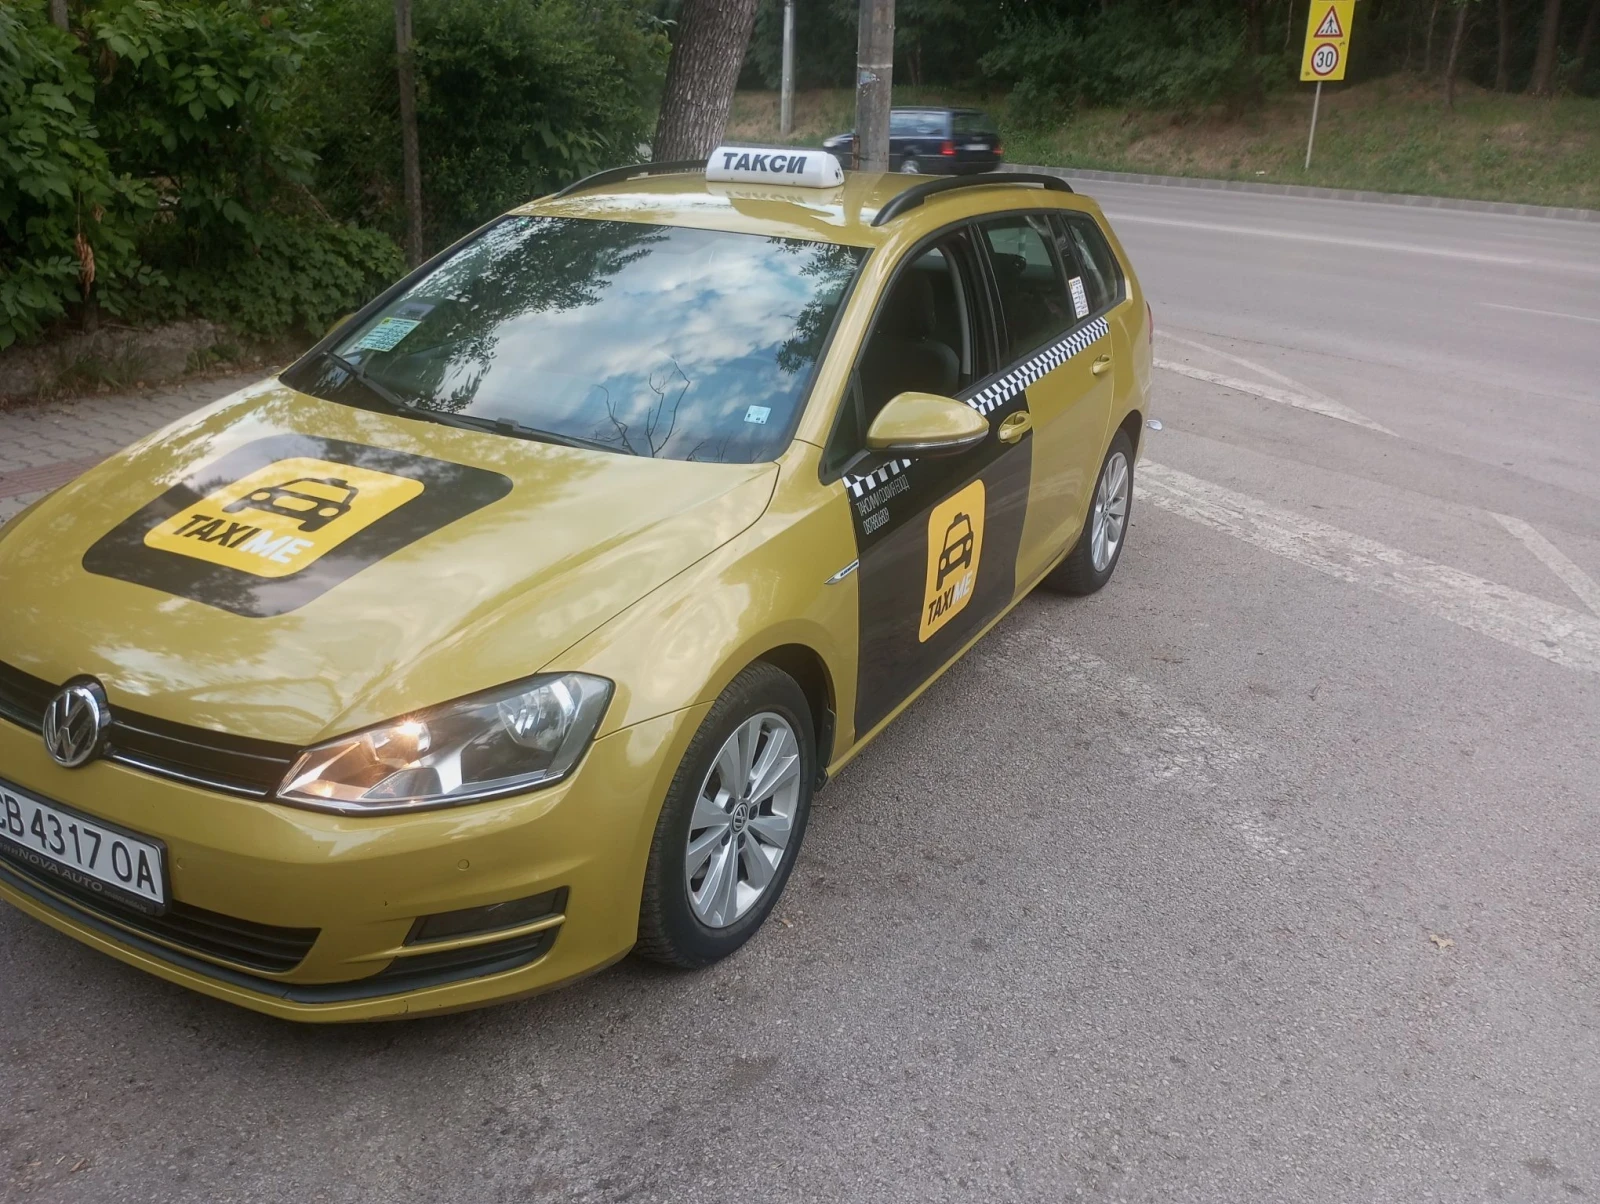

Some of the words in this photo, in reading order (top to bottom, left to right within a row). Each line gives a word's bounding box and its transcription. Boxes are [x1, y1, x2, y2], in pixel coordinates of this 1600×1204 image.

[1316, 51, 1334, 68] 30
[723, 152, 808, 174] ТАКСИ
[30, 808, 102, 870] 4317
[18, 846, 60, 875] NOVA
[62, 869, 103, 892] AUTO
